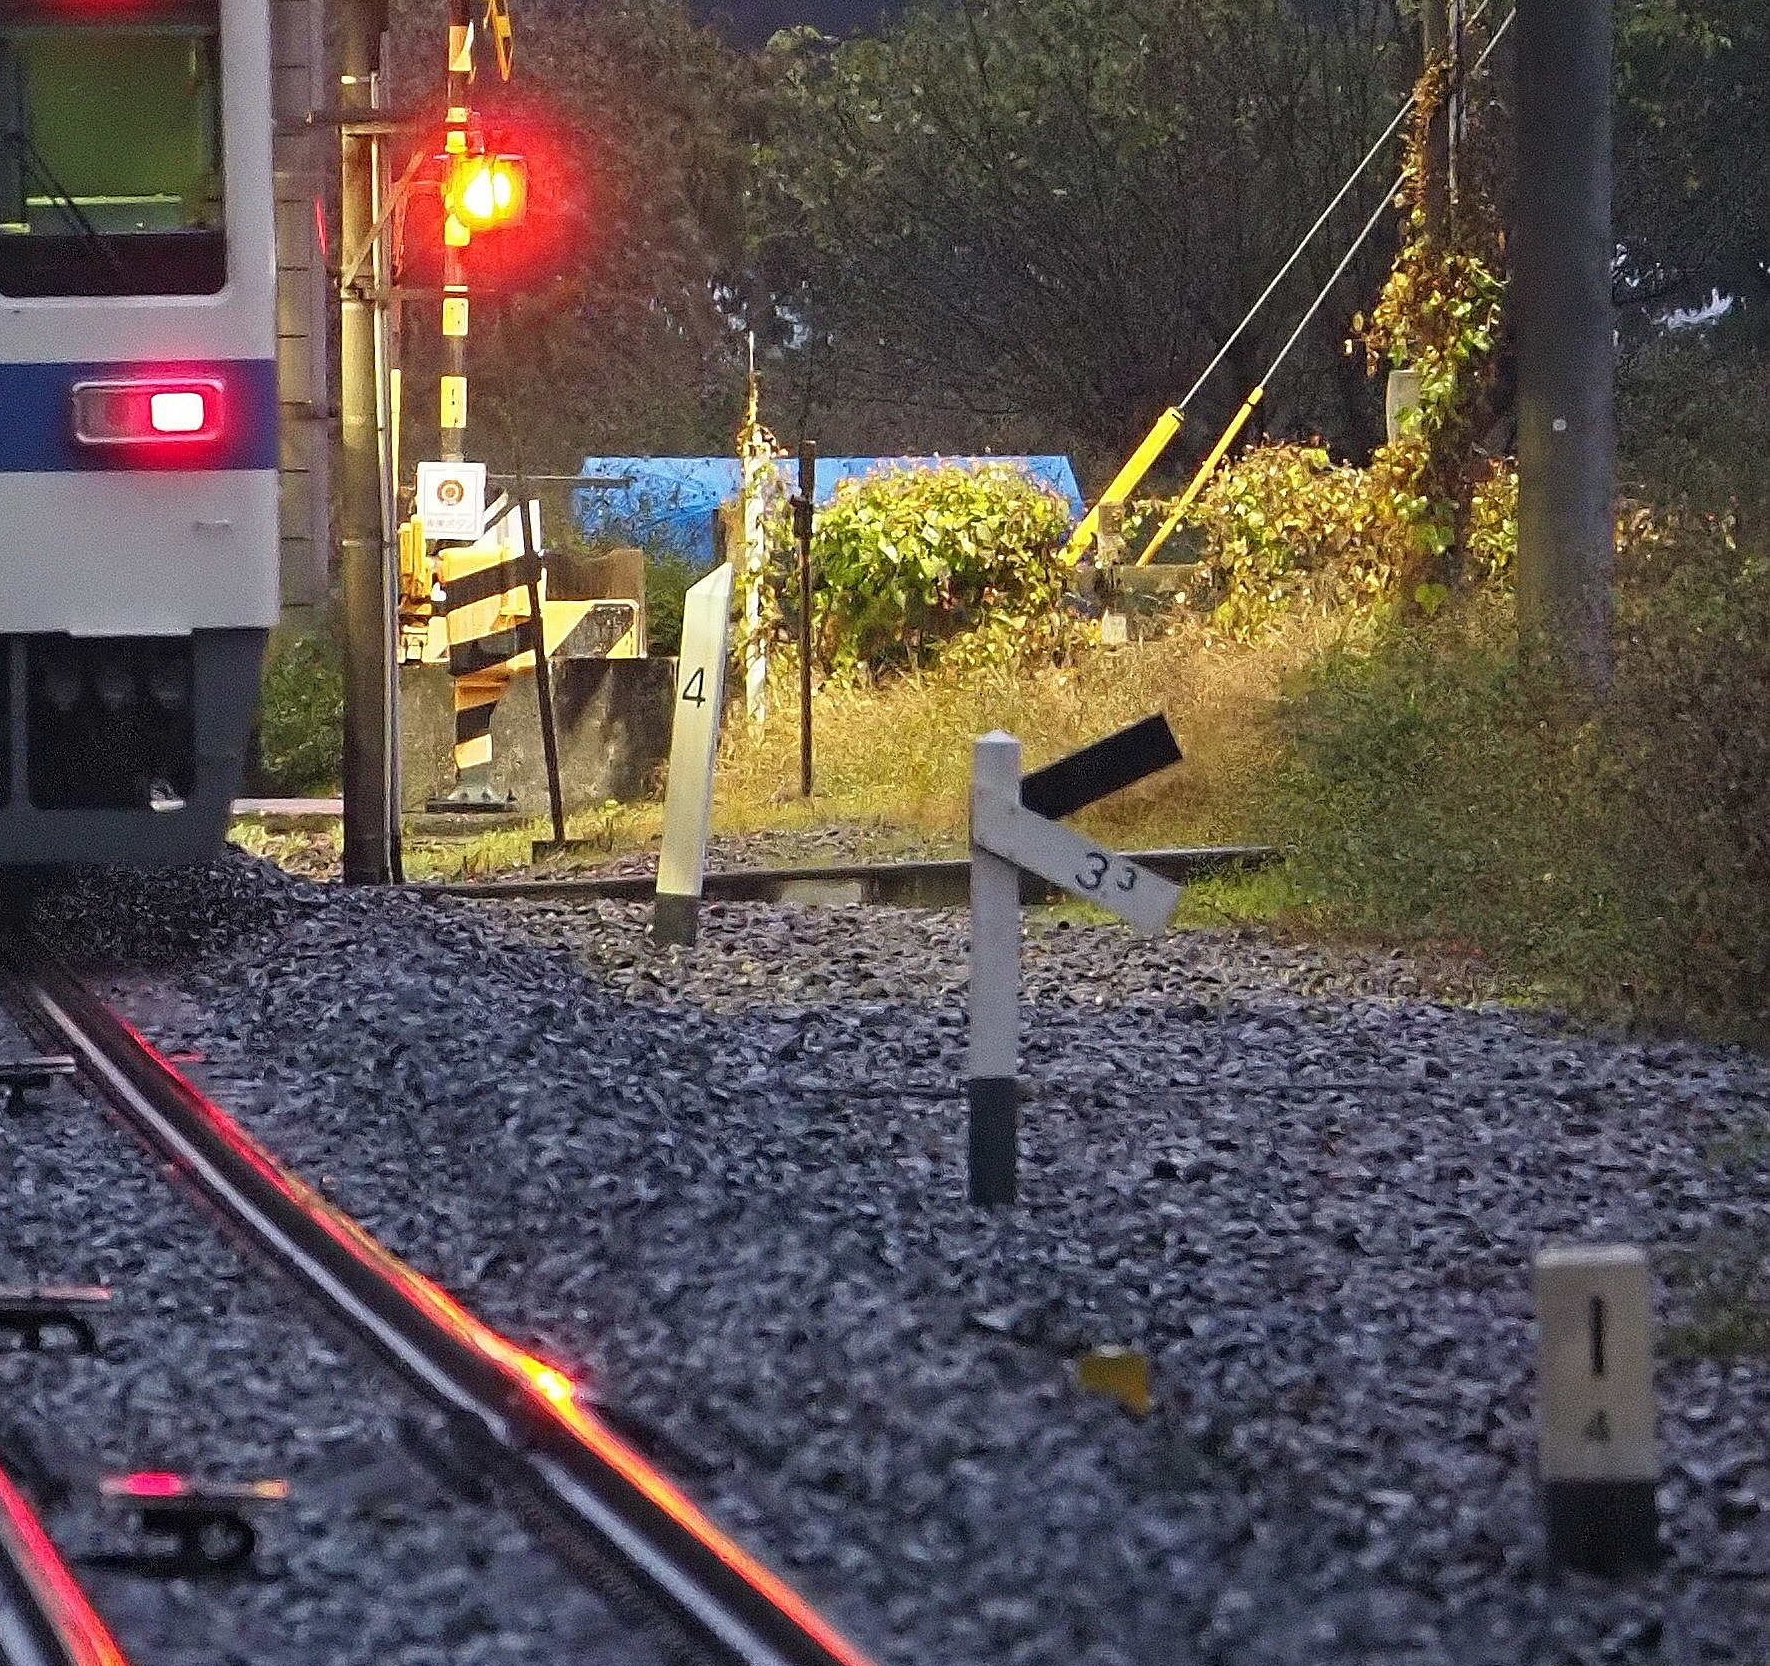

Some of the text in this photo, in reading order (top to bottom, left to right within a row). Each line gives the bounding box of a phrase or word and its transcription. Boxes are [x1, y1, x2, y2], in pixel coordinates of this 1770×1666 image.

[682, 666, 706, 709] 4
[1588, 1294, 1606, 1378] 1
[1580, 1408, 1612, 1443] 4
